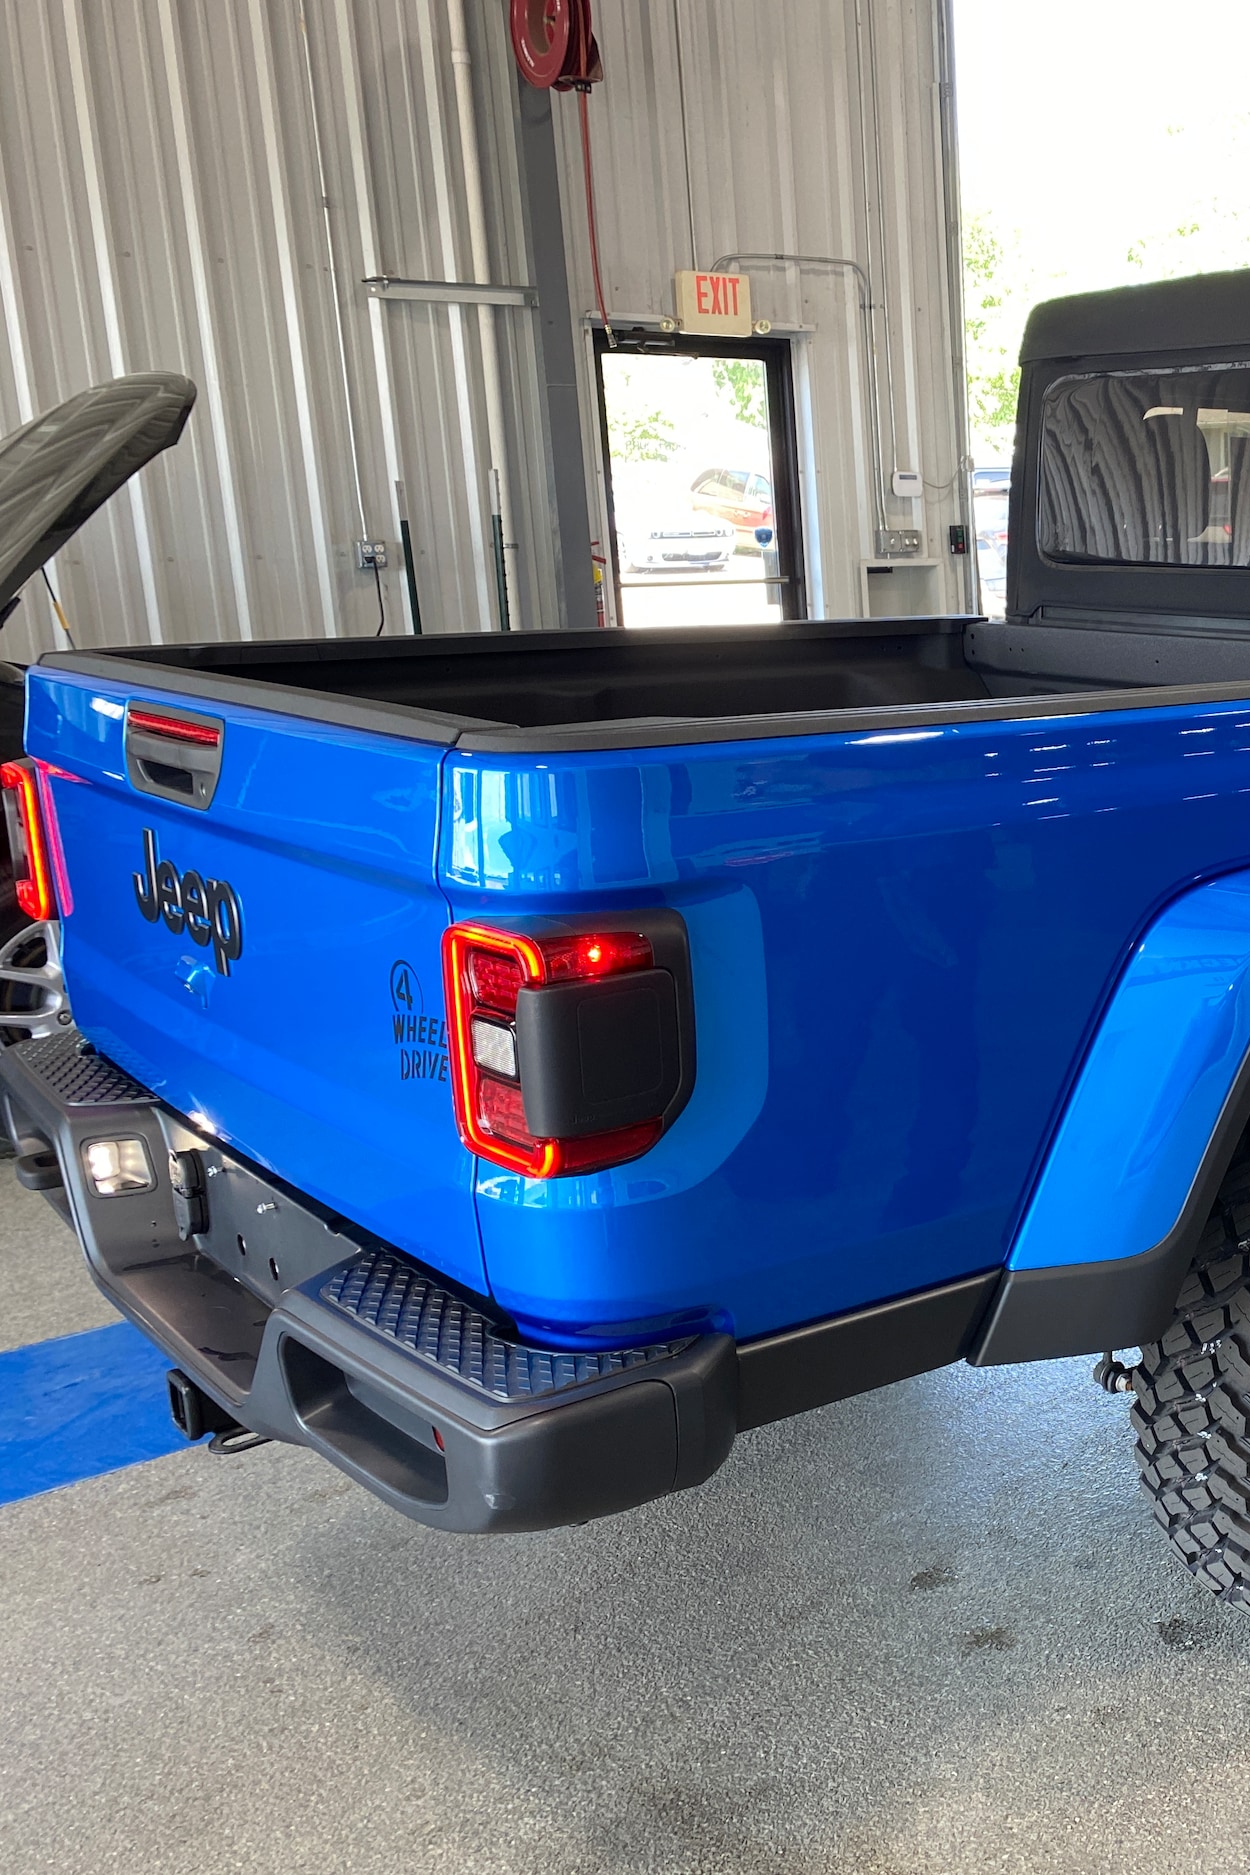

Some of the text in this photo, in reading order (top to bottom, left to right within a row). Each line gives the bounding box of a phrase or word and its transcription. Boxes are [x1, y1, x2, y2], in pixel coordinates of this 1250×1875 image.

[695, 275, 740, 316] EXIT
[132, 827, 243, 977] Jeep
[395, 968, 413, 1011] 4
[392, 1014, 448, 1049] WHEEL
[400, 1048, 449, 1082] DRIVE
